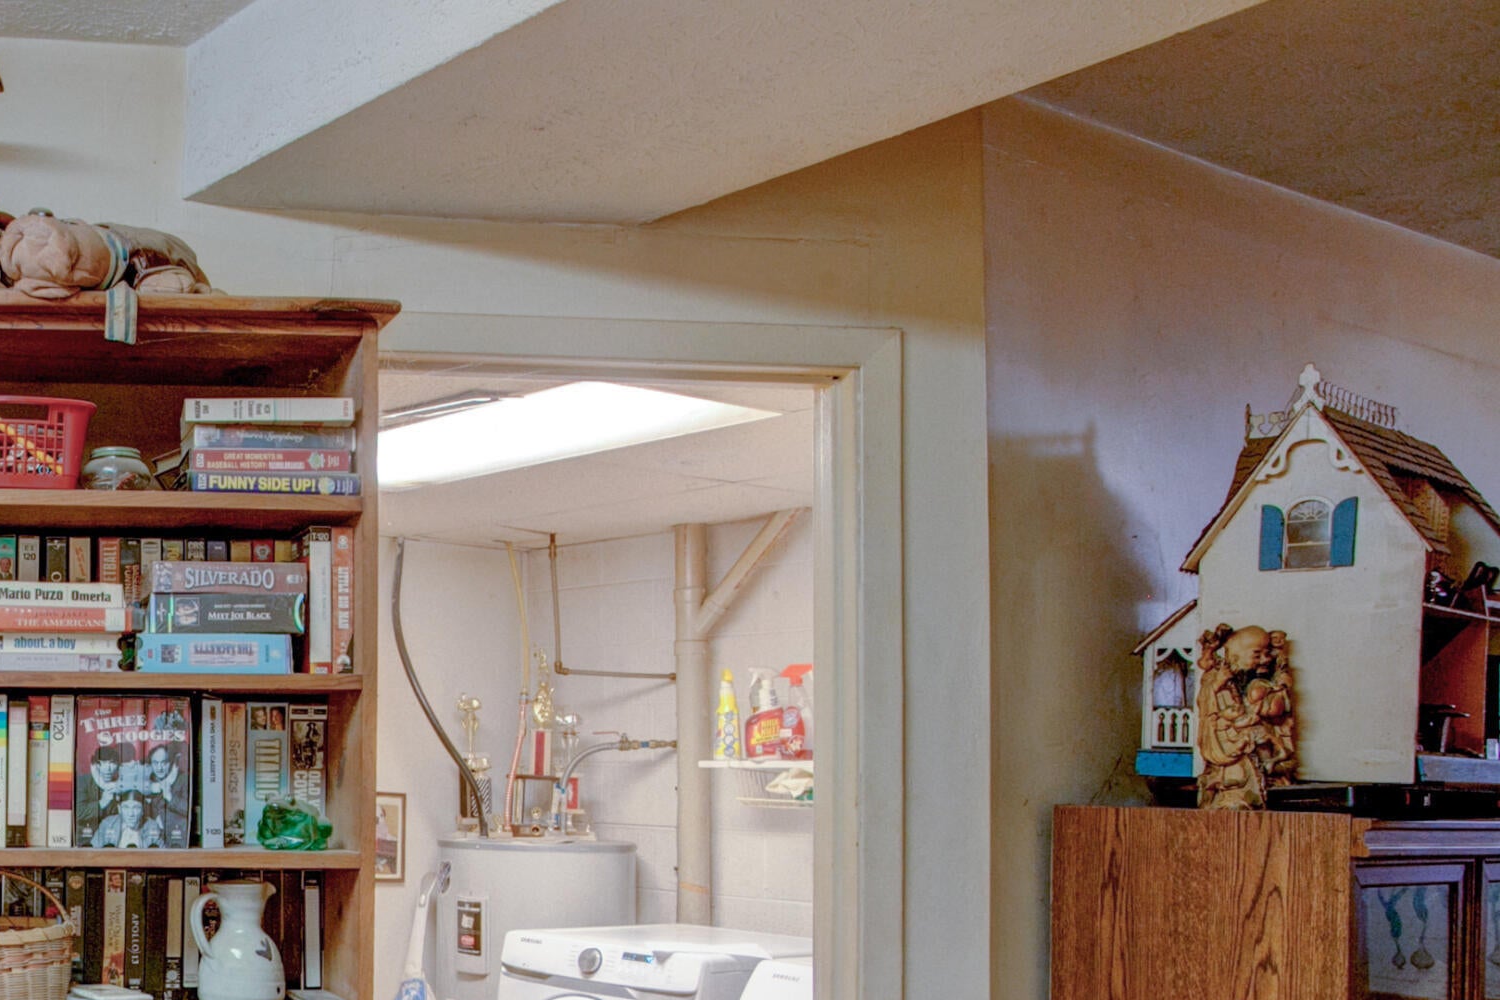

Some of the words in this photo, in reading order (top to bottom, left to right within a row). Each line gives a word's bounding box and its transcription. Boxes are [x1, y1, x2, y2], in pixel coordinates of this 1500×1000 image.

[206, 460, 237, 469] BASEBALL
[208, 474, 257, 490] FUNNY
[258, 475, 291, 491] SIDE
[293, 477, 316, 493] UP!
[185, 566, 275, 591] SILVERADO
[0, 587, 31, 601] Mario
[34, 587, 64, 602] Puzo
[71, 589, 112, 603] Omerta
[16, 618, 37, 627] THE
[42, 618, 105, 627] AMERICANS
[207, 610, 230, 621] MEET
[230, 610, 246, 622] JOE
[246, 610, 272, 622] BLACK
[57, 636, 77, 651] boy
[94, 708, 112, 717] the
[51, 708, 66, 741] T-120
[80, 714, 147, 734] THREE
[97, 729, 186, 747] STOOGES
[228, 739, 241, 793] Settlers
[255, 738, 282, 800] TITANIC
[293, 769, 308, 800] COW
[307, 770, 322, 796] OLD
[130, 913, 141, 952] APOLLO
[130, 955, 141, 965] 13
